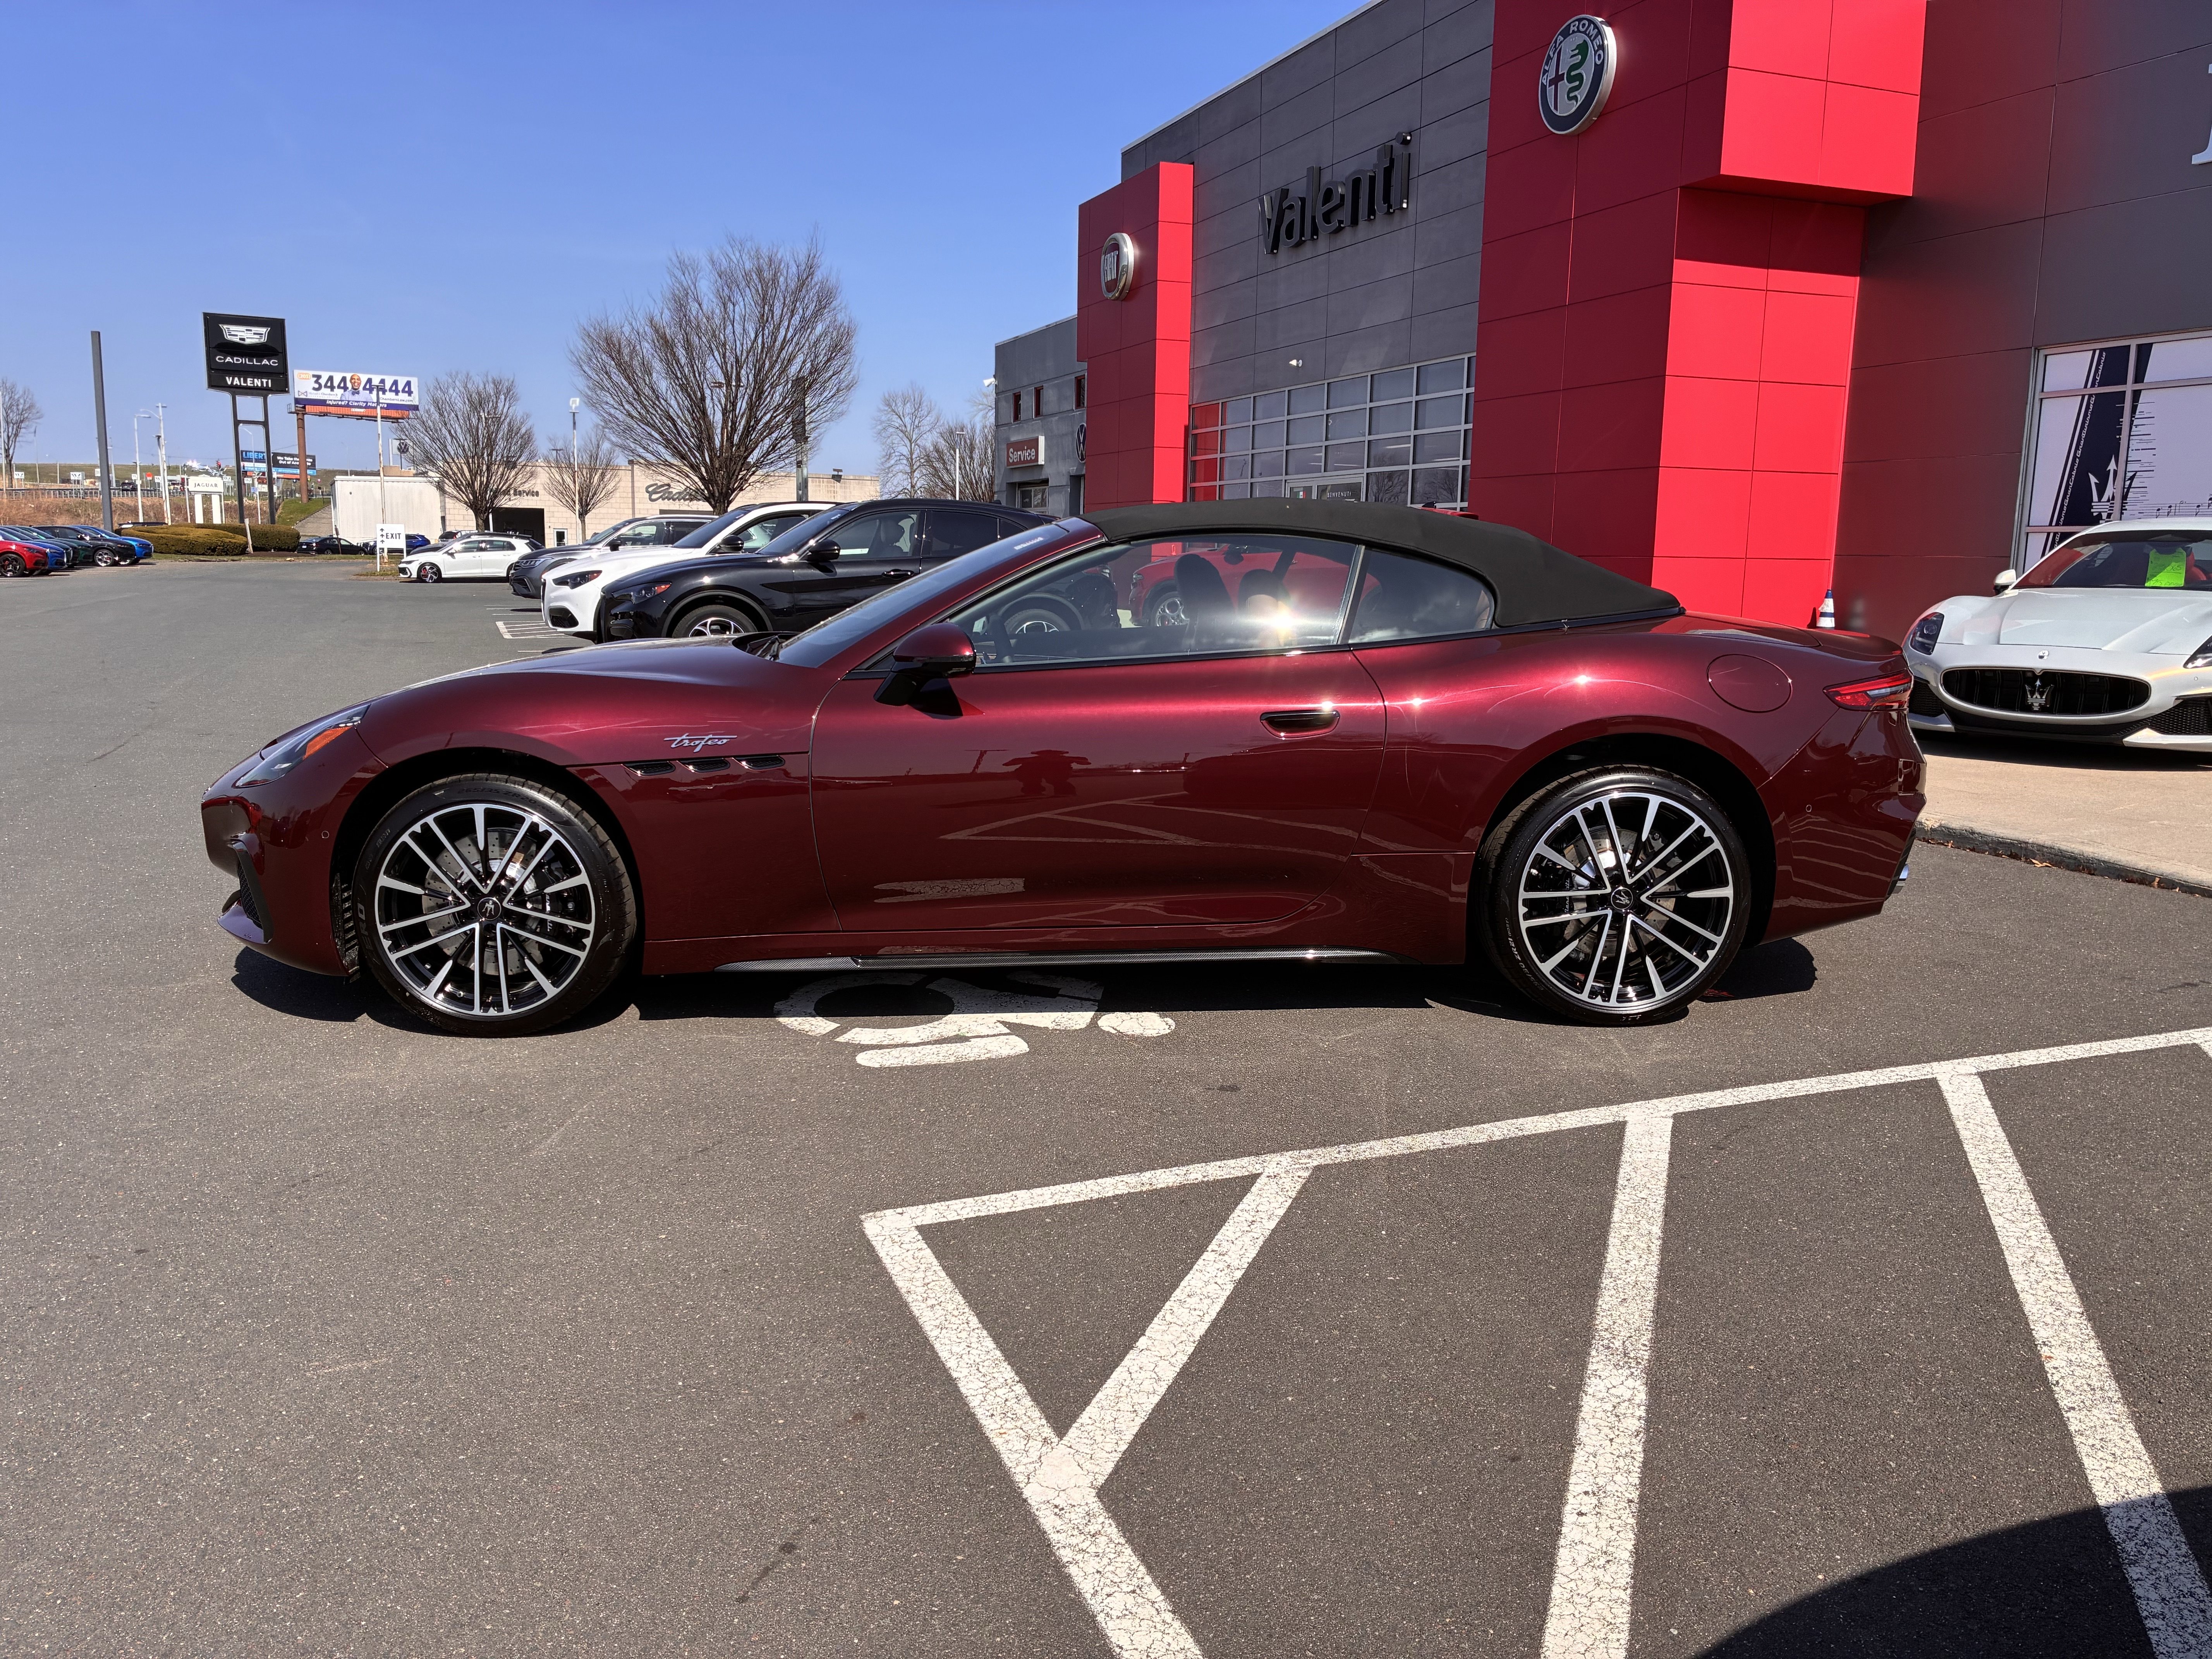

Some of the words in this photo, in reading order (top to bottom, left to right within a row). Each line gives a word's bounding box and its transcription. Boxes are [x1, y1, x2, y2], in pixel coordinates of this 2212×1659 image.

[1542, 35, 1564, 85] ALFA
[1570, 20, 1604, 65] ROMEO
[1258, 132, 1412, 255] Valenti
[1104, 251, 1118, 282] FIAT
[216, 356, 278, 366] CADILLAC
[225, 376, 271, 387] VALENTI
[312, 374, 349, 392] 344
[362, 378, 413, 397] 4444
[1009, 446, 1036, 463] Service
[513, 489, 539, 497] Service
[663, 733, 738, 752] trofeo
